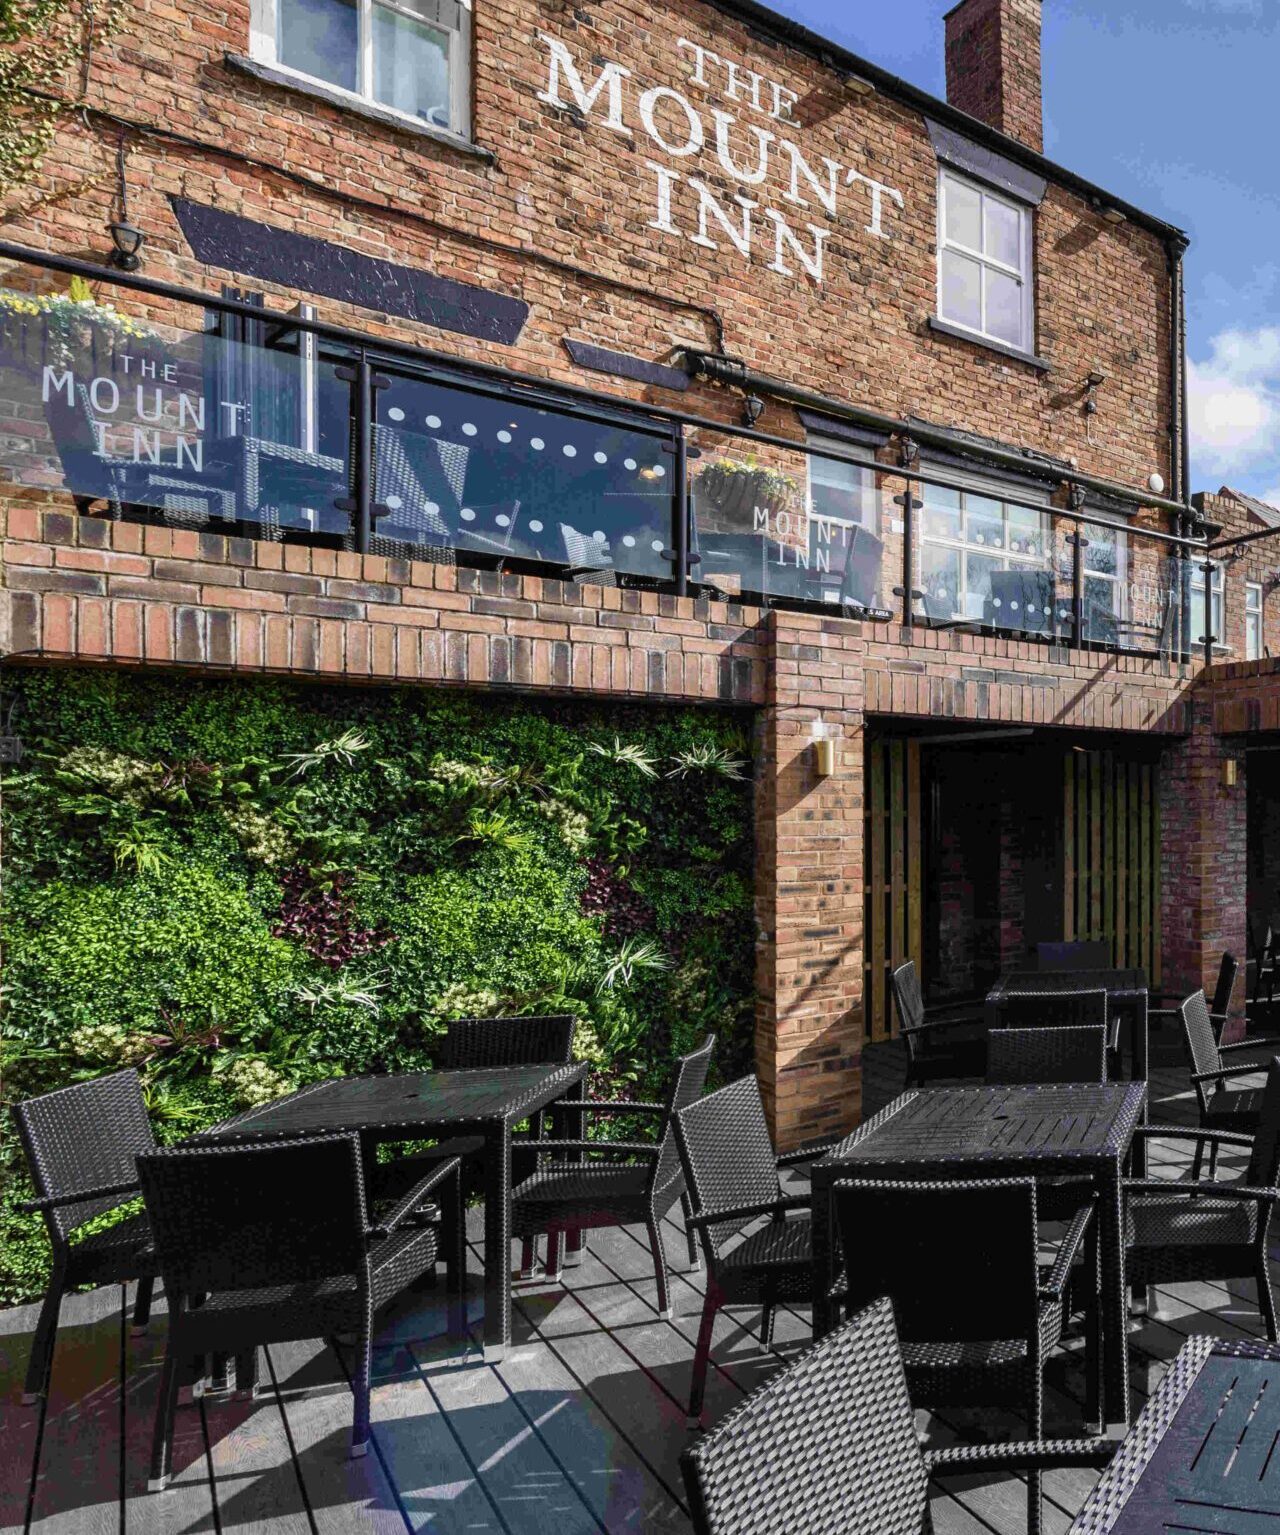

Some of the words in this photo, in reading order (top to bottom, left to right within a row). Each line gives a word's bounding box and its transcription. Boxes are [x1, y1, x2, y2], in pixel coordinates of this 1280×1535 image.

[677, 37, 801, 129] THE
[536, 33, 905, 240] MOUNT
[646, 160, 830, 283] INN
[120, 354, 178, 384] THE
[42, 365, 246, 437] MOUNT
[92, 420, 203, 473] INN
[753, 505, 848, 548] MOUNT
[776, 541, 830, 573] INN
